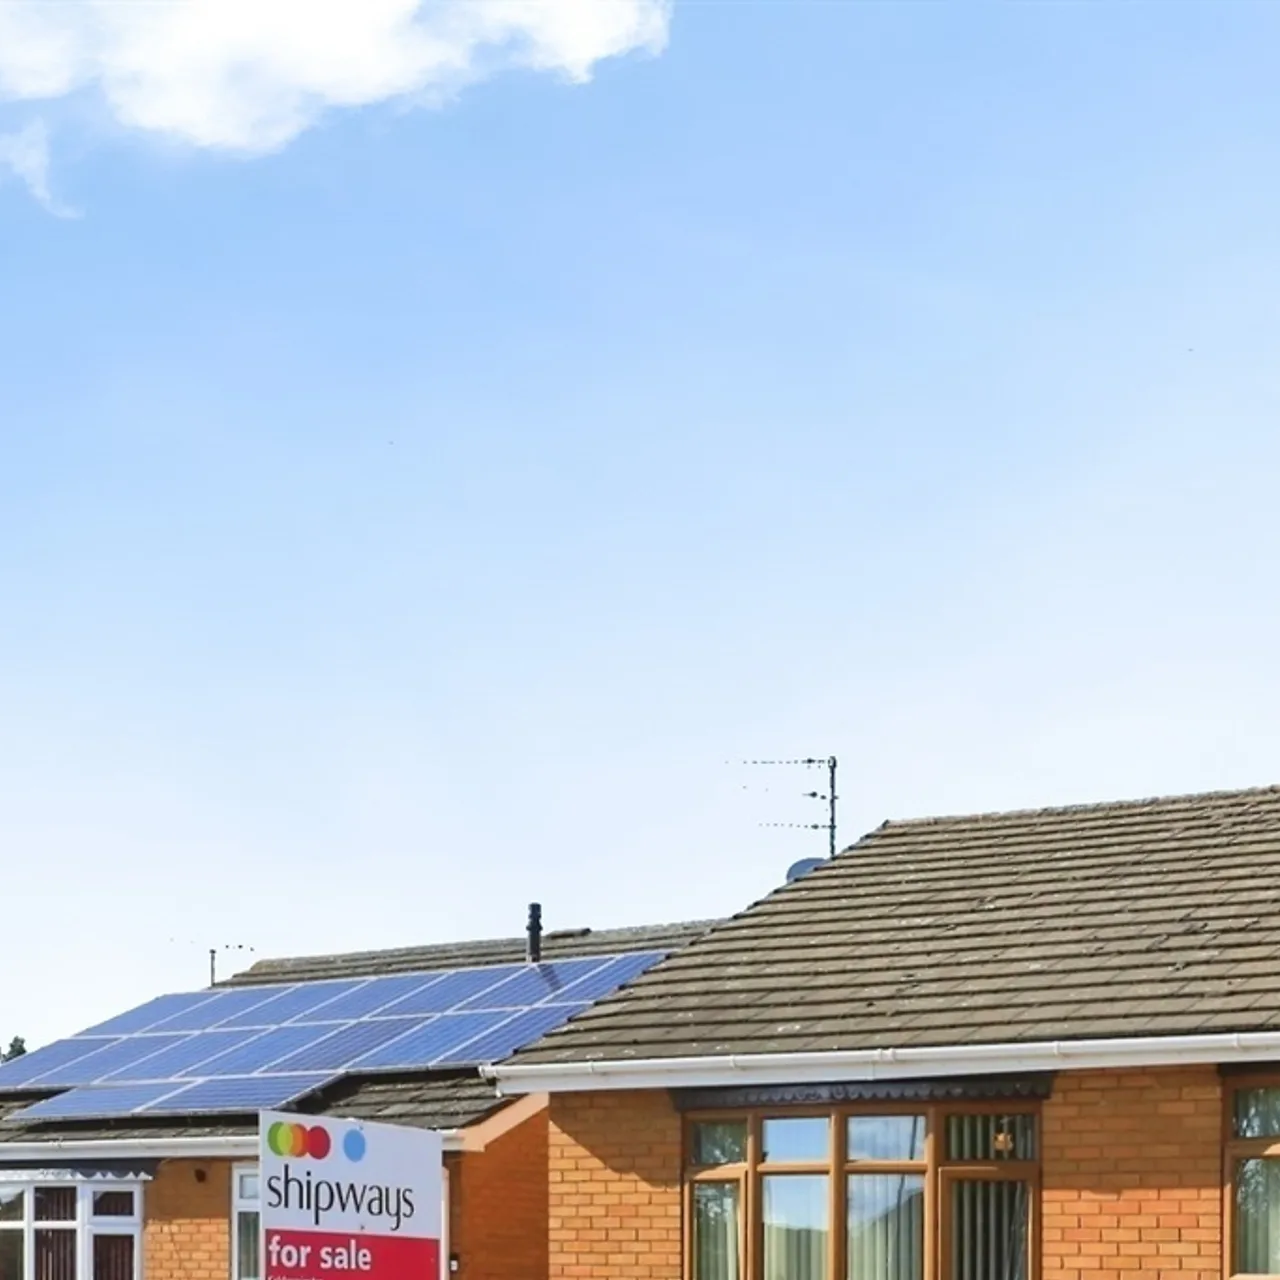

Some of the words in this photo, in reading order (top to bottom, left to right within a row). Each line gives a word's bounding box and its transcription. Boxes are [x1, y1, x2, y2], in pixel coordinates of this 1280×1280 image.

[267, 1163, 415, 1231] shipways
[269, 1236, 311, 1268] for
[320, 1240, 371, 1270] sale
